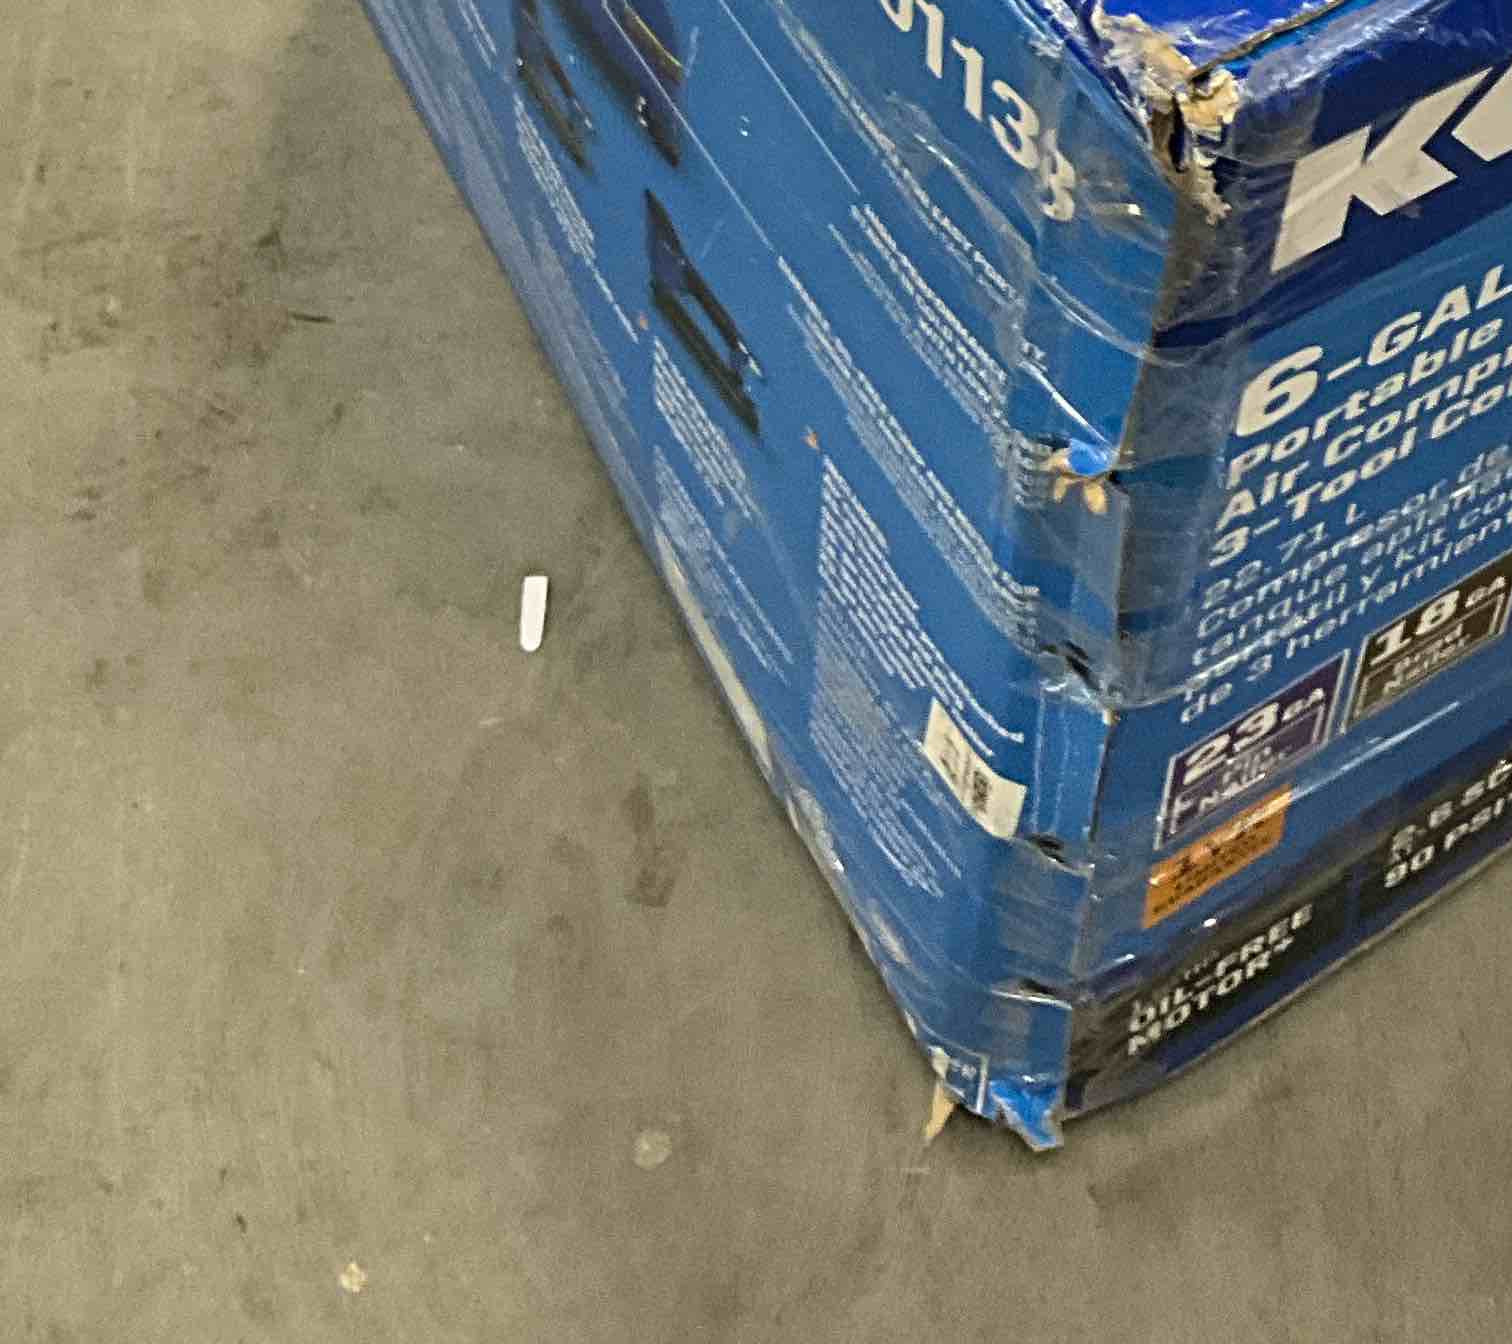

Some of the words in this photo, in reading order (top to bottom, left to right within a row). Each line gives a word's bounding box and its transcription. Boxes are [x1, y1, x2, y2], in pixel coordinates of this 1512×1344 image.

[1227, 314, 1500, 491] Portable
[1207, 433, 1416, 568] 3-Tool
[1216, 464, 1312, 533] Air
[1369, 589, 1459, 667] 18
[1181, 702, 1281, 787] 23
